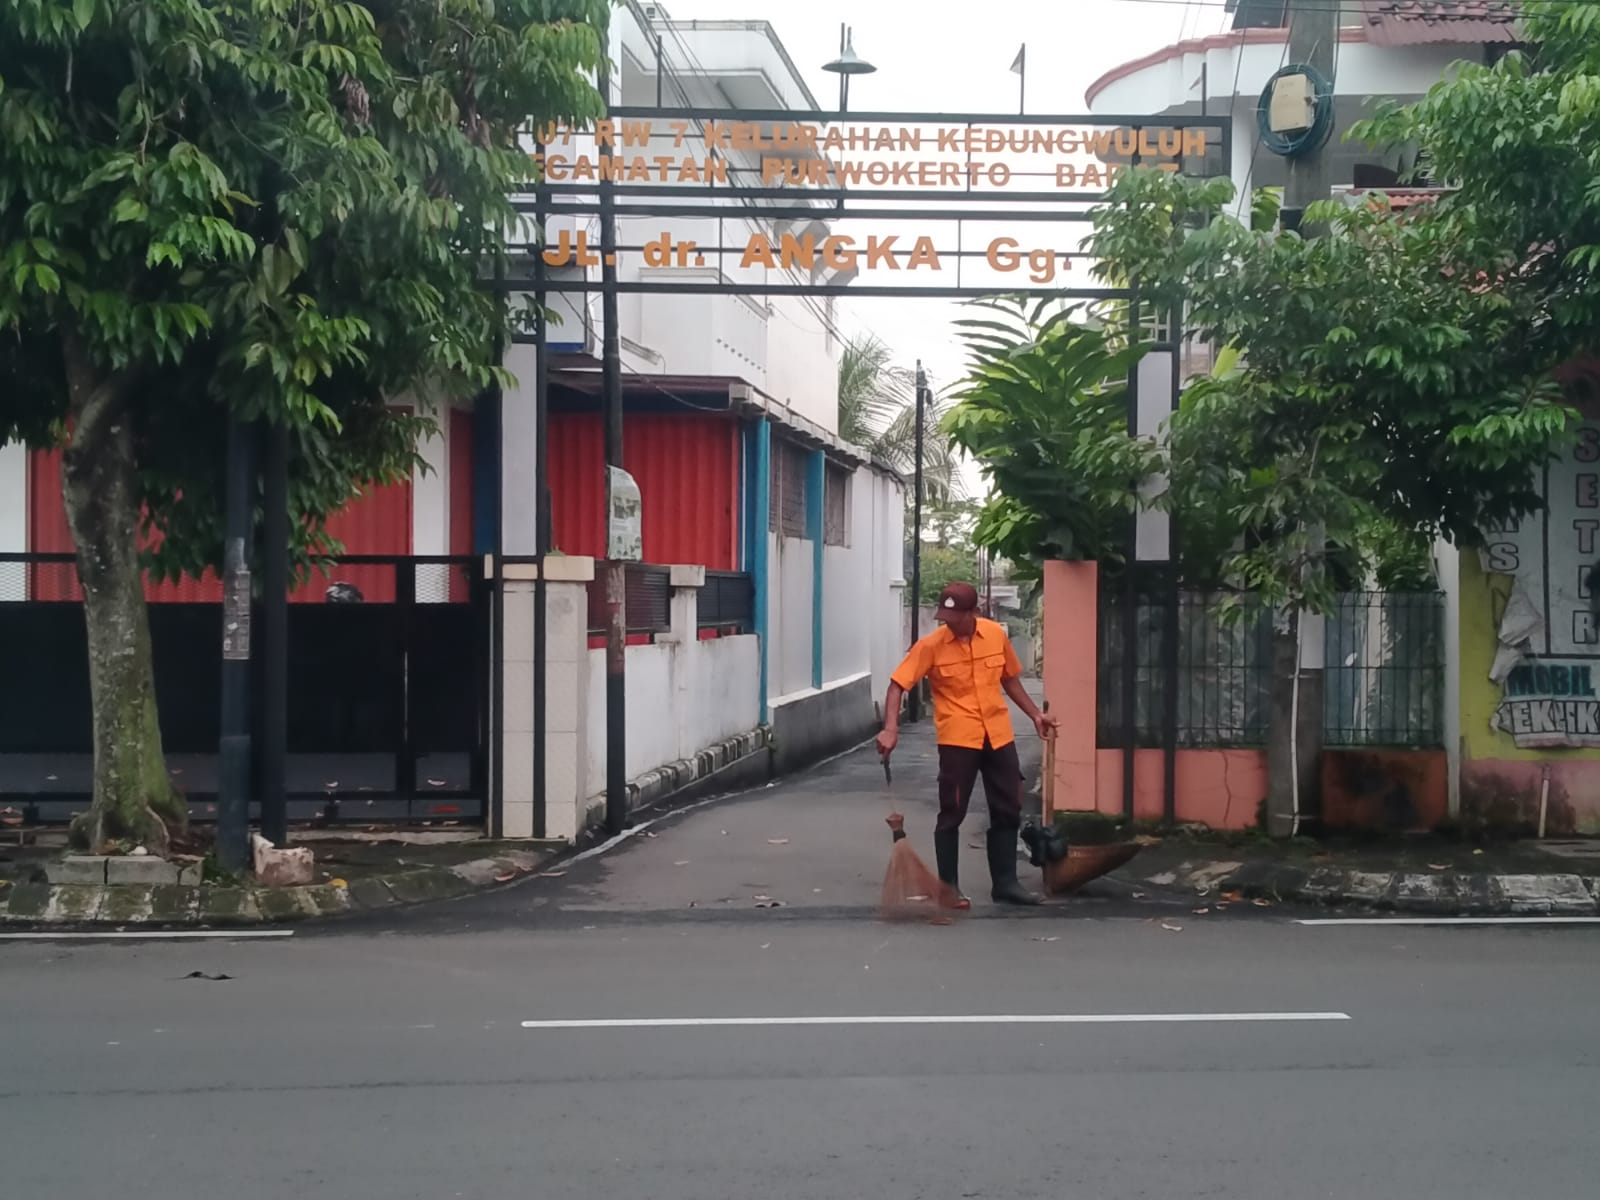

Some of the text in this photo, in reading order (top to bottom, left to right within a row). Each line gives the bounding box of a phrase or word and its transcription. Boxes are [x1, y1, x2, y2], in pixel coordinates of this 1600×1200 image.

[594, 118, 652, 148] RW
[669, 122, 689, 148] 7
[704, 121, 921, 152] KELURAHAN
[937, 128, 1207, 157] KEDUNGWULUH
[527, 152, 727, 183] ECAMATAN
[761, 157, 1011, 187] PURWOKERTO
[541, 230, 1072, 283] JL. dr. ANGKA Gg.
[1506, 664, 1596, 697] MOBIL
